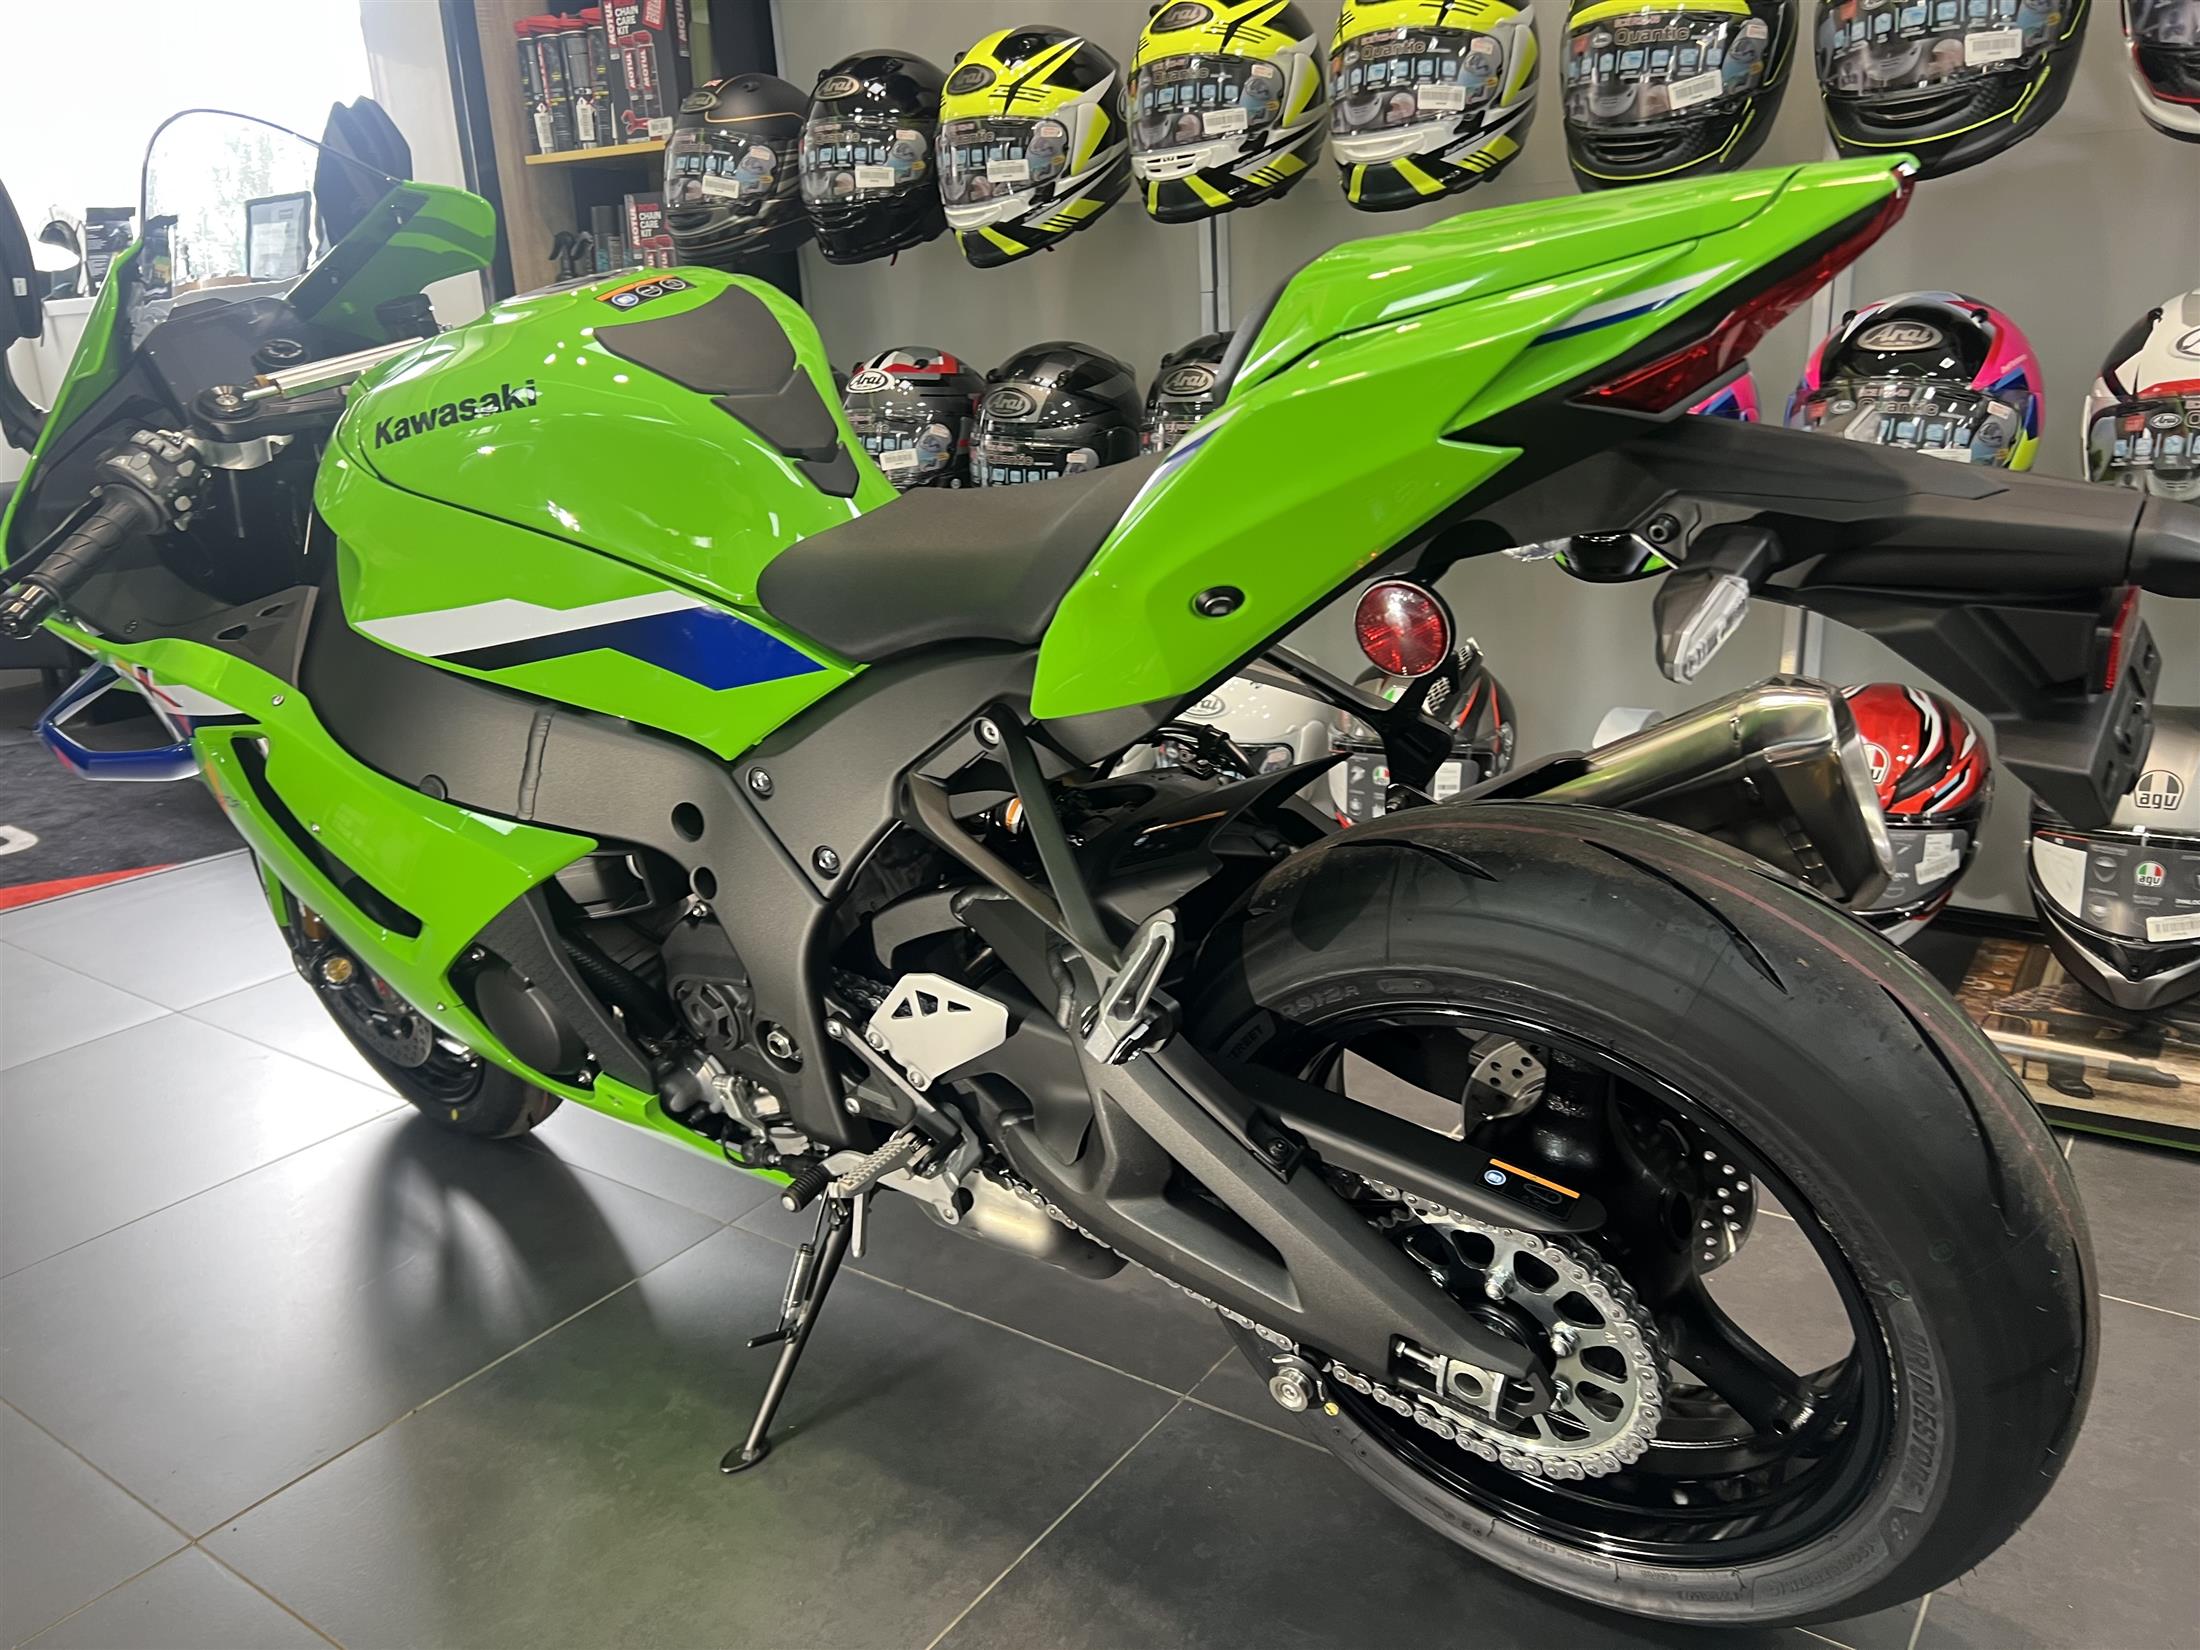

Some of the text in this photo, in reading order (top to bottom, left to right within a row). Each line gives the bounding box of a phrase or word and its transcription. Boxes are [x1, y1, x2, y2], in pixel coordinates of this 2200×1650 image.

[615, 5, 639, 17] CHAIN
[604, 2, 617, 45] MOTUL
[616, 15, 636, 26] CARE
[675, 0, 688, 41] MOTU
[617, 25, 629, 35] KIT
[626, 51, 636, 88] MOTUL
[640, 49, 651, 88] MOTUL
[639, 210, 661, 221] CHAIN
[629, 206, 641, 246] MOTUL
[640, 219, 660, 229] CARE
[641, 228, 653, 237] KIT
[1867, 324, 1932, 344] Arai
[853, 374, 881, 387] Arai
[1168, 371, 1208, 387] Arai
[989, 393, 1025, 411] Arai
[374, 379, 538, 449] Kawasaki
[2139, 792, 2177, 809] agv
[2138, 874, 2161, 886] agv
